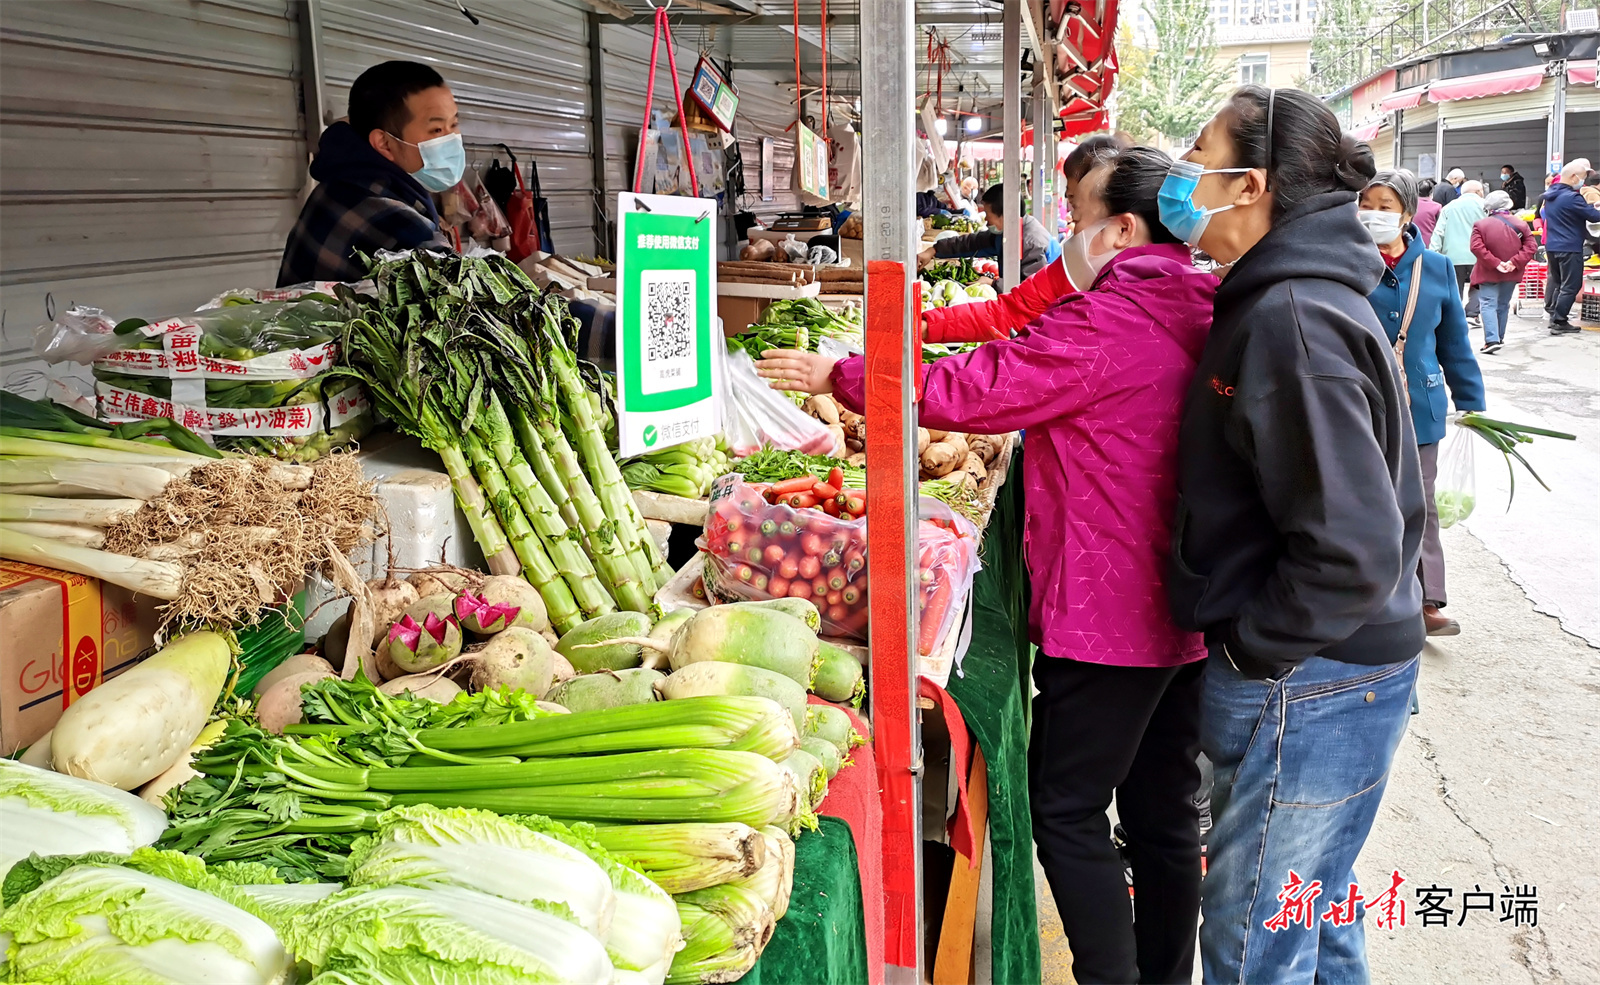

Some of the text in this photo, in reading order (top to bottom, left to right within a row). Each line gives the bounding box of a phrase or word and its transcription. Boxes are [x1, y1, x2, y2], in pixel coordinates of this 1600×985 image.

[637, 233, 699, 250] 推荐使用微信支付
[661, 417, 699, 441] 微信支付
